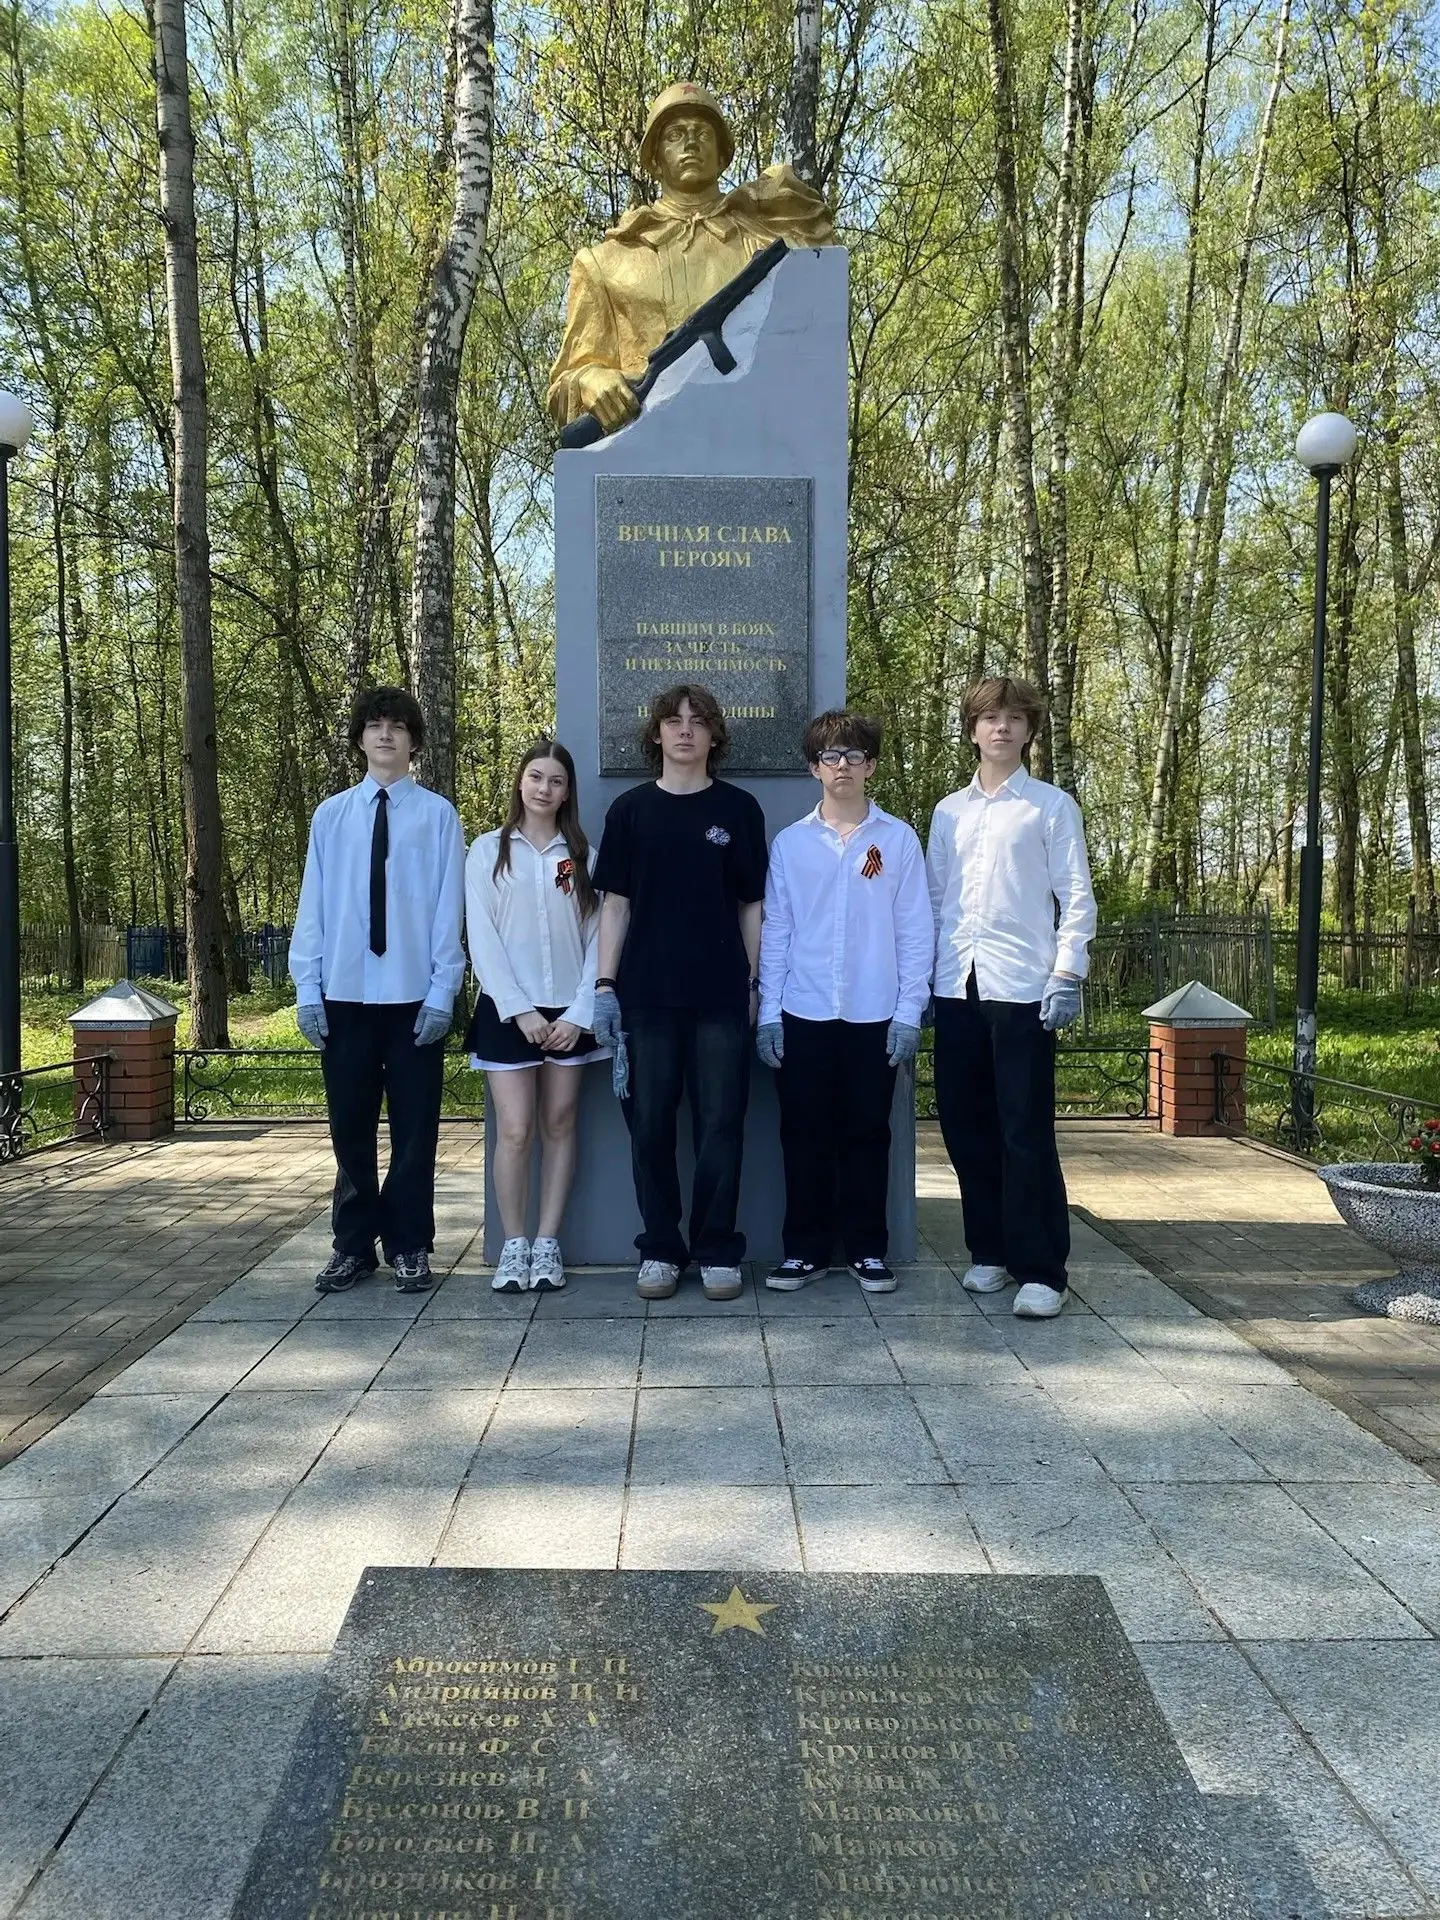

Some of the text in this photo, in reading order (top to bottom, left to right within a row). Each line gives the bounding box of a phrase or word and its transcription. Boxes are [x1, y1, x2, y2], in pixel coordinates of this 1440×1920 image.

[618, 525, 792, 543] ВЕЧНАЯ СЛАВА
[659, 550, 751, 568] ГЕРОЯМ
[636, 622, 775, 637] ПАВШИМ В БОЯХ
[664, 641, 741, 653] ЗА ЧЕСТЬ
[625, 658, 787, 672] И НЕЗАВИСИМОСТЬ
[722, 706, 776, 719] ДИНЫ
[391, 1656, 557, 1676] Абросимов
[382, 1683, 557, 1704] Андриянов
